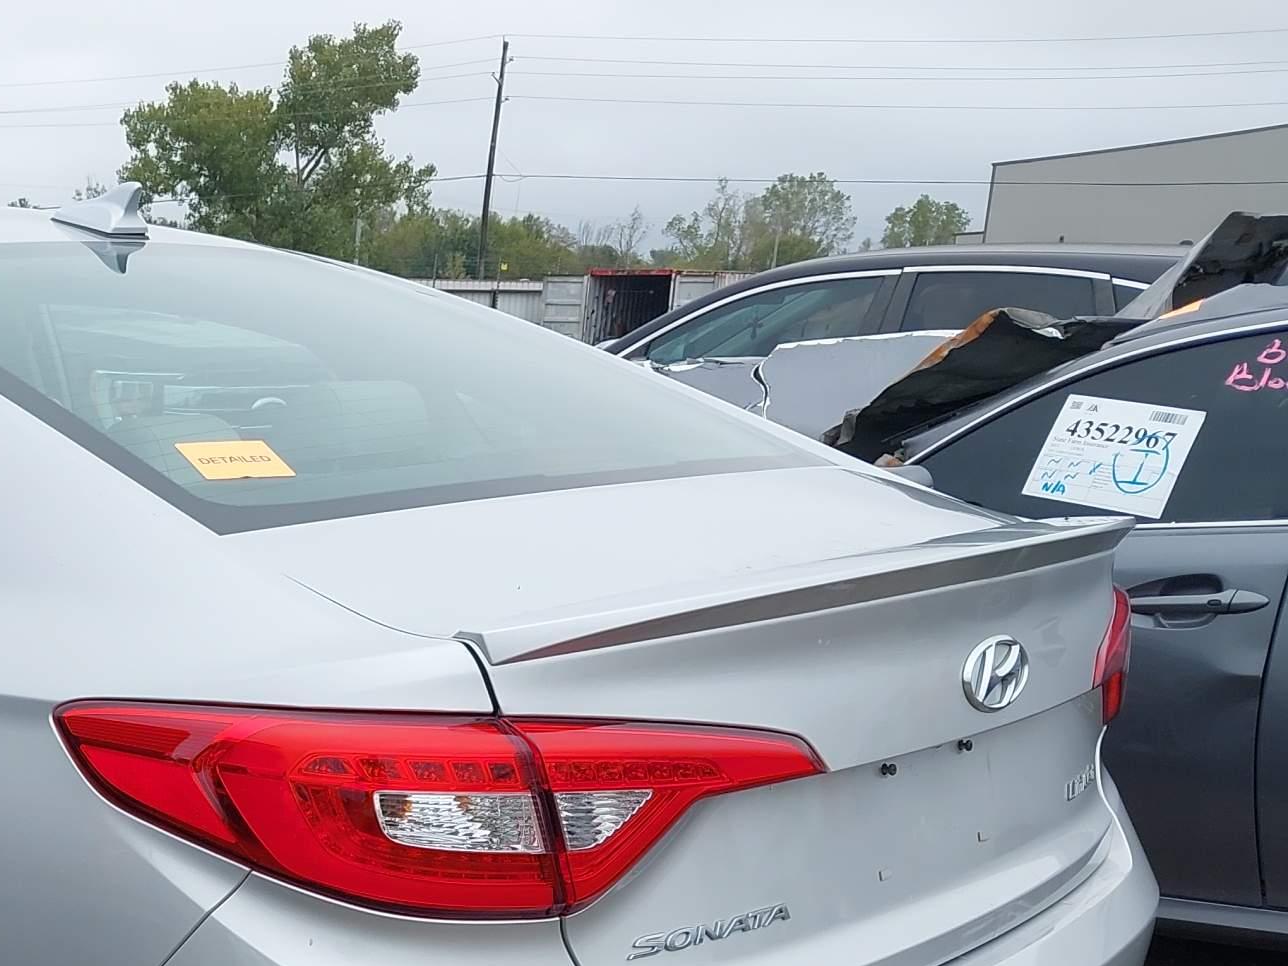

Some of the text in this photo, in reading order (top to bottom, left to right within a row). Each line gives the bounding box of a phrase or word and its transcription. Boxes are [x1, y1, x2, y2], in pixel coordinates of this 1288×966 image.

[1066, 419, 1178, 451] 43522967
[198, 455, 272, 465] DETAILED
[626, 902, 791, 961] SONATA
